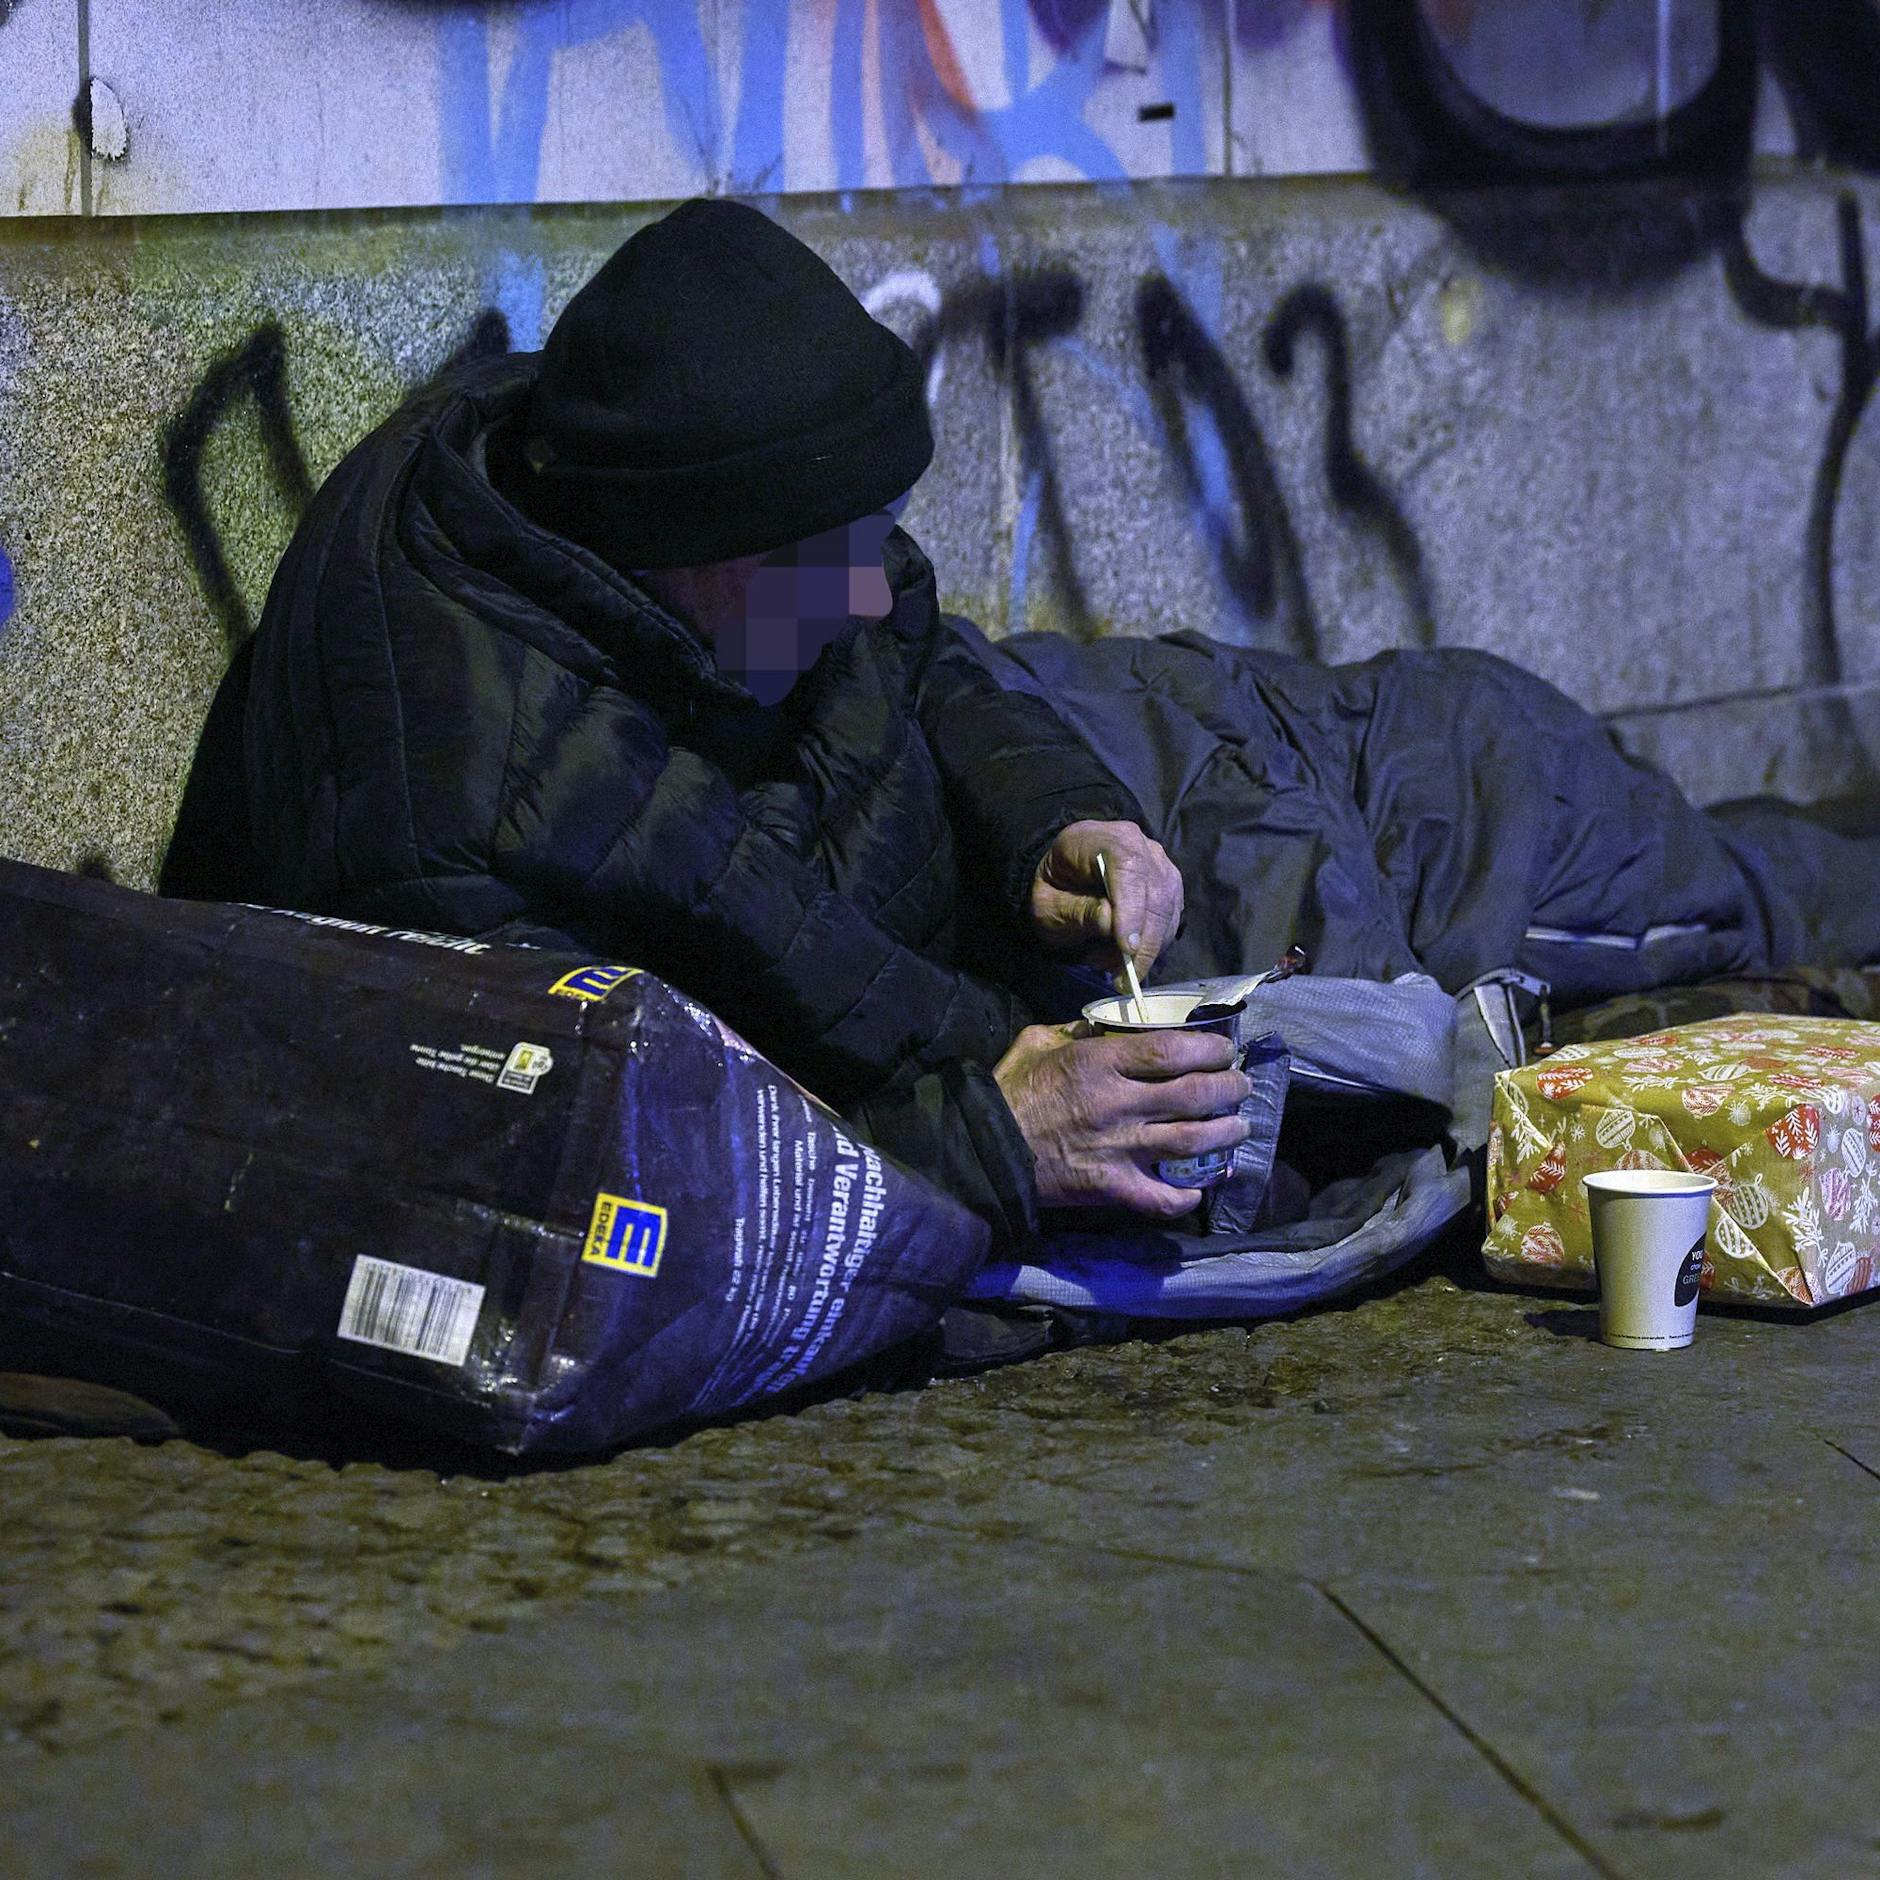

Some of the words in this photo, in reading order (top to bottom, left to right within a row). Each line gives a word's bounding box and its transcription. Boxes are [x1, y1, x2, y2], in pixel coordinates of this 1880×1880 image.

[756, 1088, 768, 1149] verwenden
[768, 1085, 779, 1112] Dank
[757, 1150, 769, 1173] und
[793, 1139, 805, 1186] Material
[757, 1174, 769, 1207] helfen
[794, 1188, 805, 1211] und
[590, 1201, 612, 1256] EDEKA
[606, 1205, 660, 1267] E
[733, 1217, 746, 1268] Tragkraft
[789, 1163, 859, 1342] Verantwortung
[725, 1286, 739, 1302] kg
